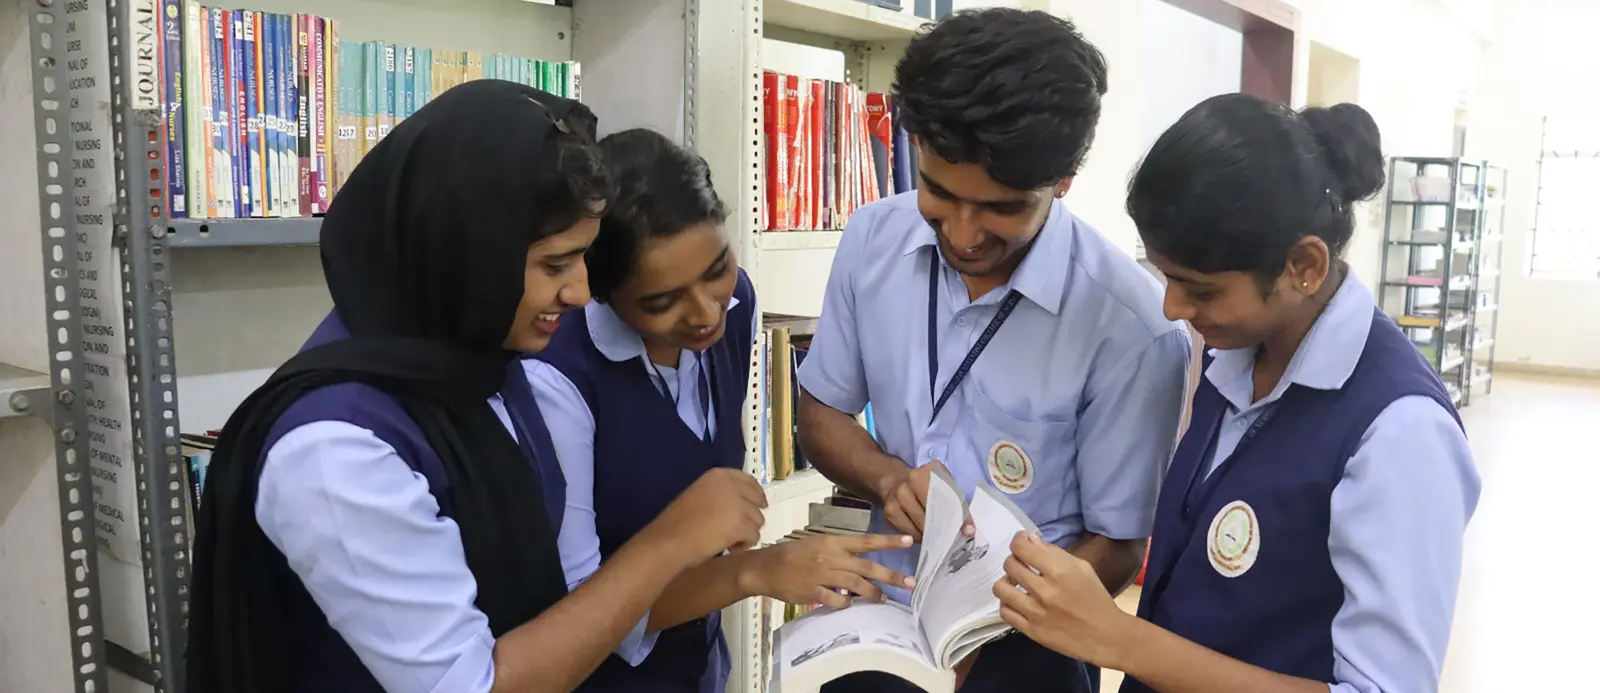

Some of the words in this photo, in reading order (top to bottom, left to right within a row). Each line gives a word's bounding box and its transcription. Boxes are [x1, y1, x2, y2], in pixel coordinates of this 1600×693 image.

[66, 0, 88, 13] URSING
[67, 40, 81, 52] URSE
[137, 0, 154, 106] JOURNAL
[316, 33, 324, 100] COMMUNICATIVE
[69, 77, 96, 90] UCATION
[174, 72, 182, 102] English
[71, 121, 92, 132] TIONAL
[169, 112, 177, 141] Nurses
[299, 96, 308, 137] English
[316, 101, 325, 137] ENGLISH
[83, 324, 114, 336] NURSING
[84, 363, 109, 376] TRATION
